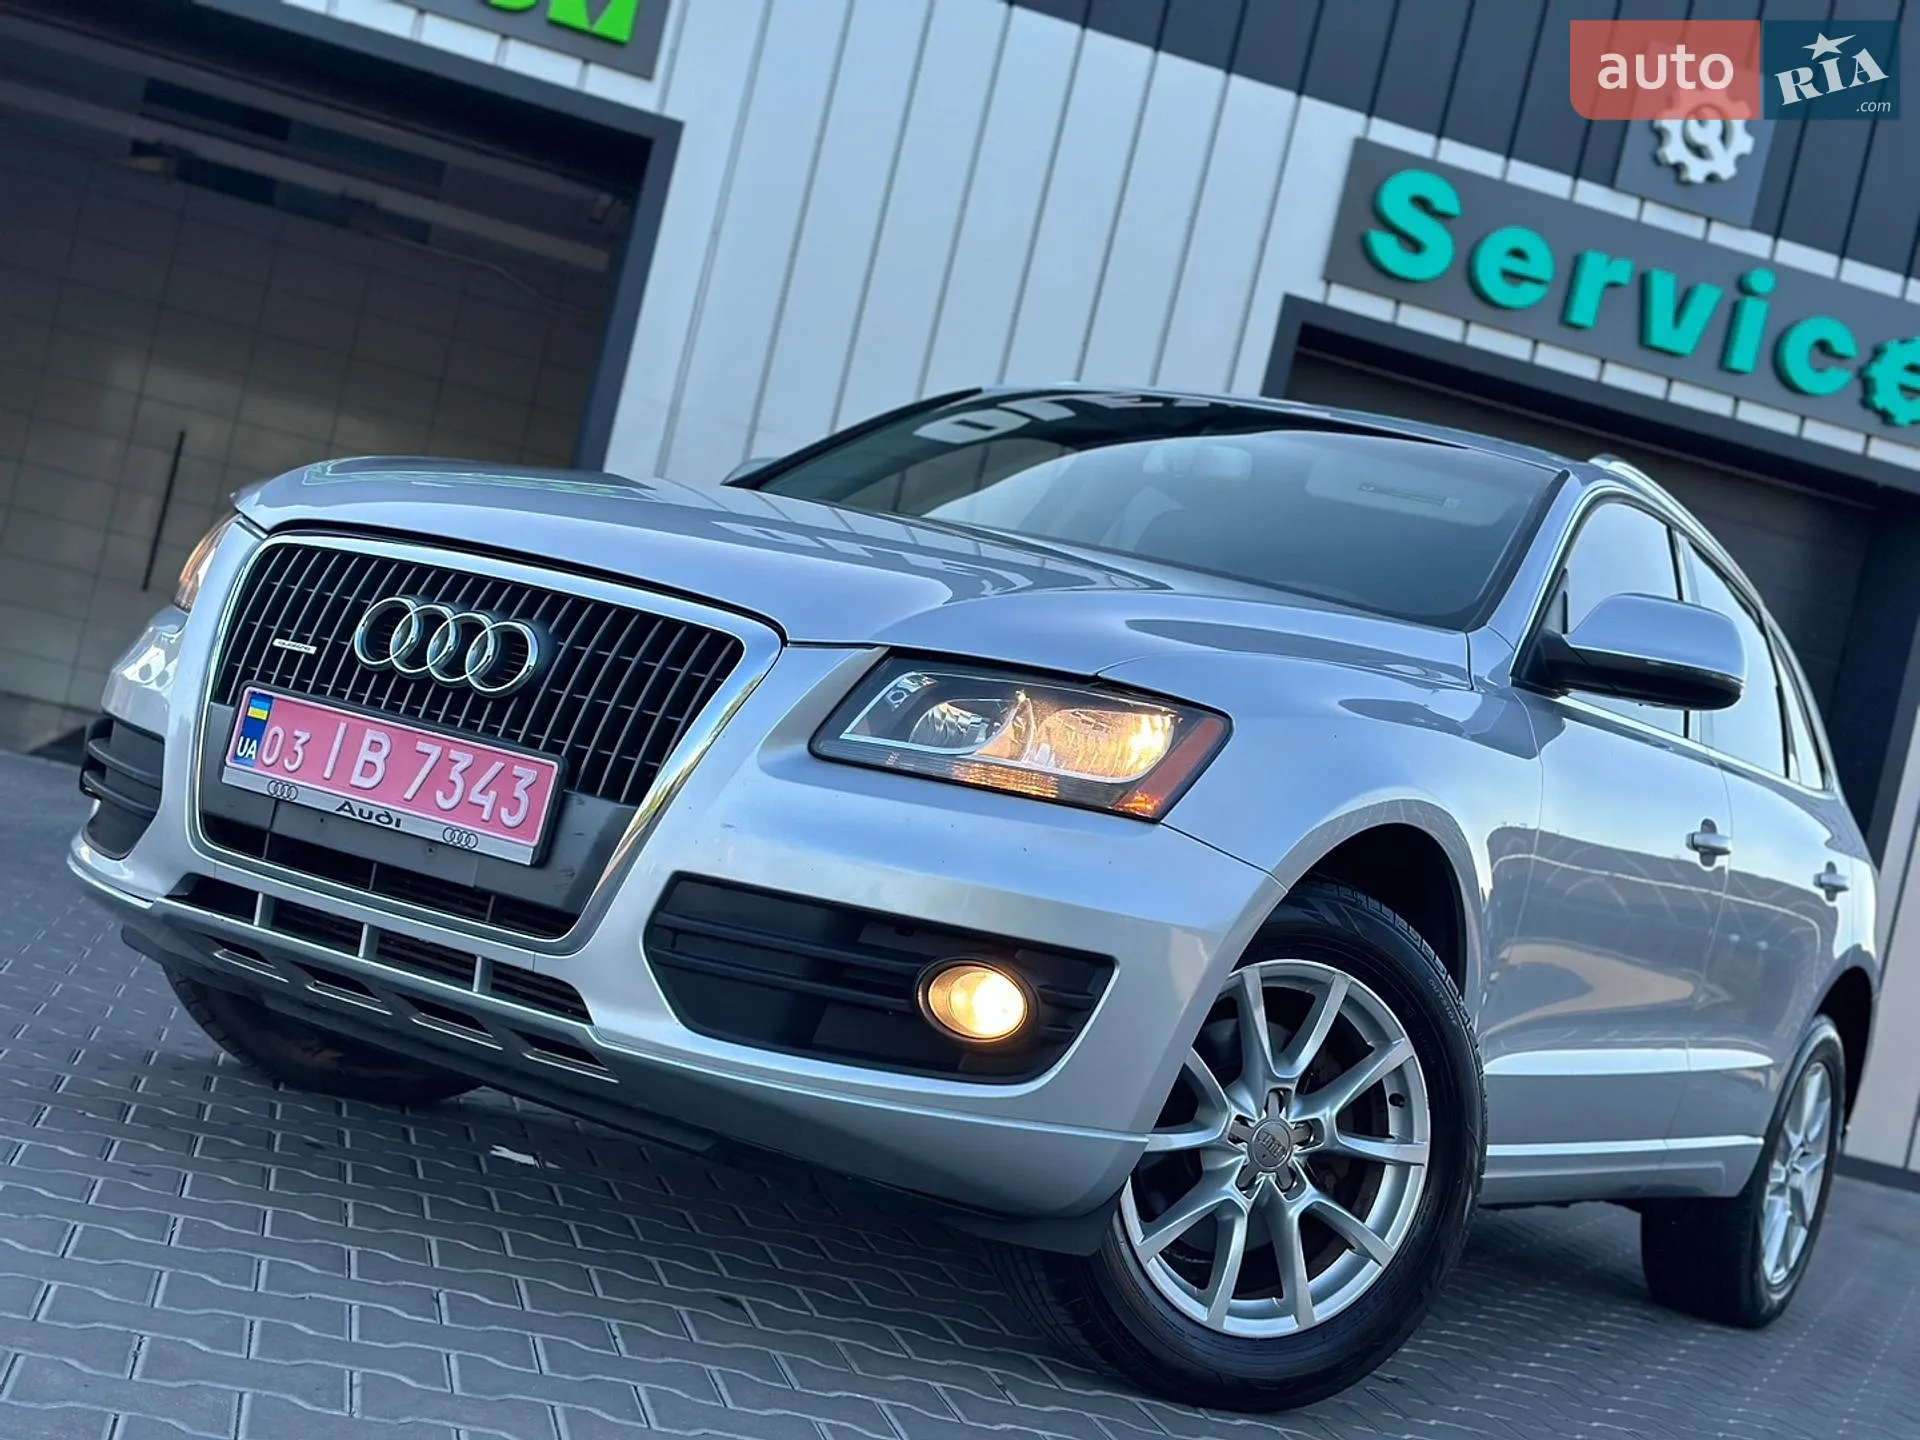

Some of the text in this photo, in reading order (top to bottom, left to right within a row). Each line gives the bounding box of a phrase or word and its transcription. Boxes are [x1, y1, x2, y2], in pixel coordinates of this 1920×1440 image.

[236, 735, 257, 761] UA
[260, 722, 539, 829] 03 IB 7343
